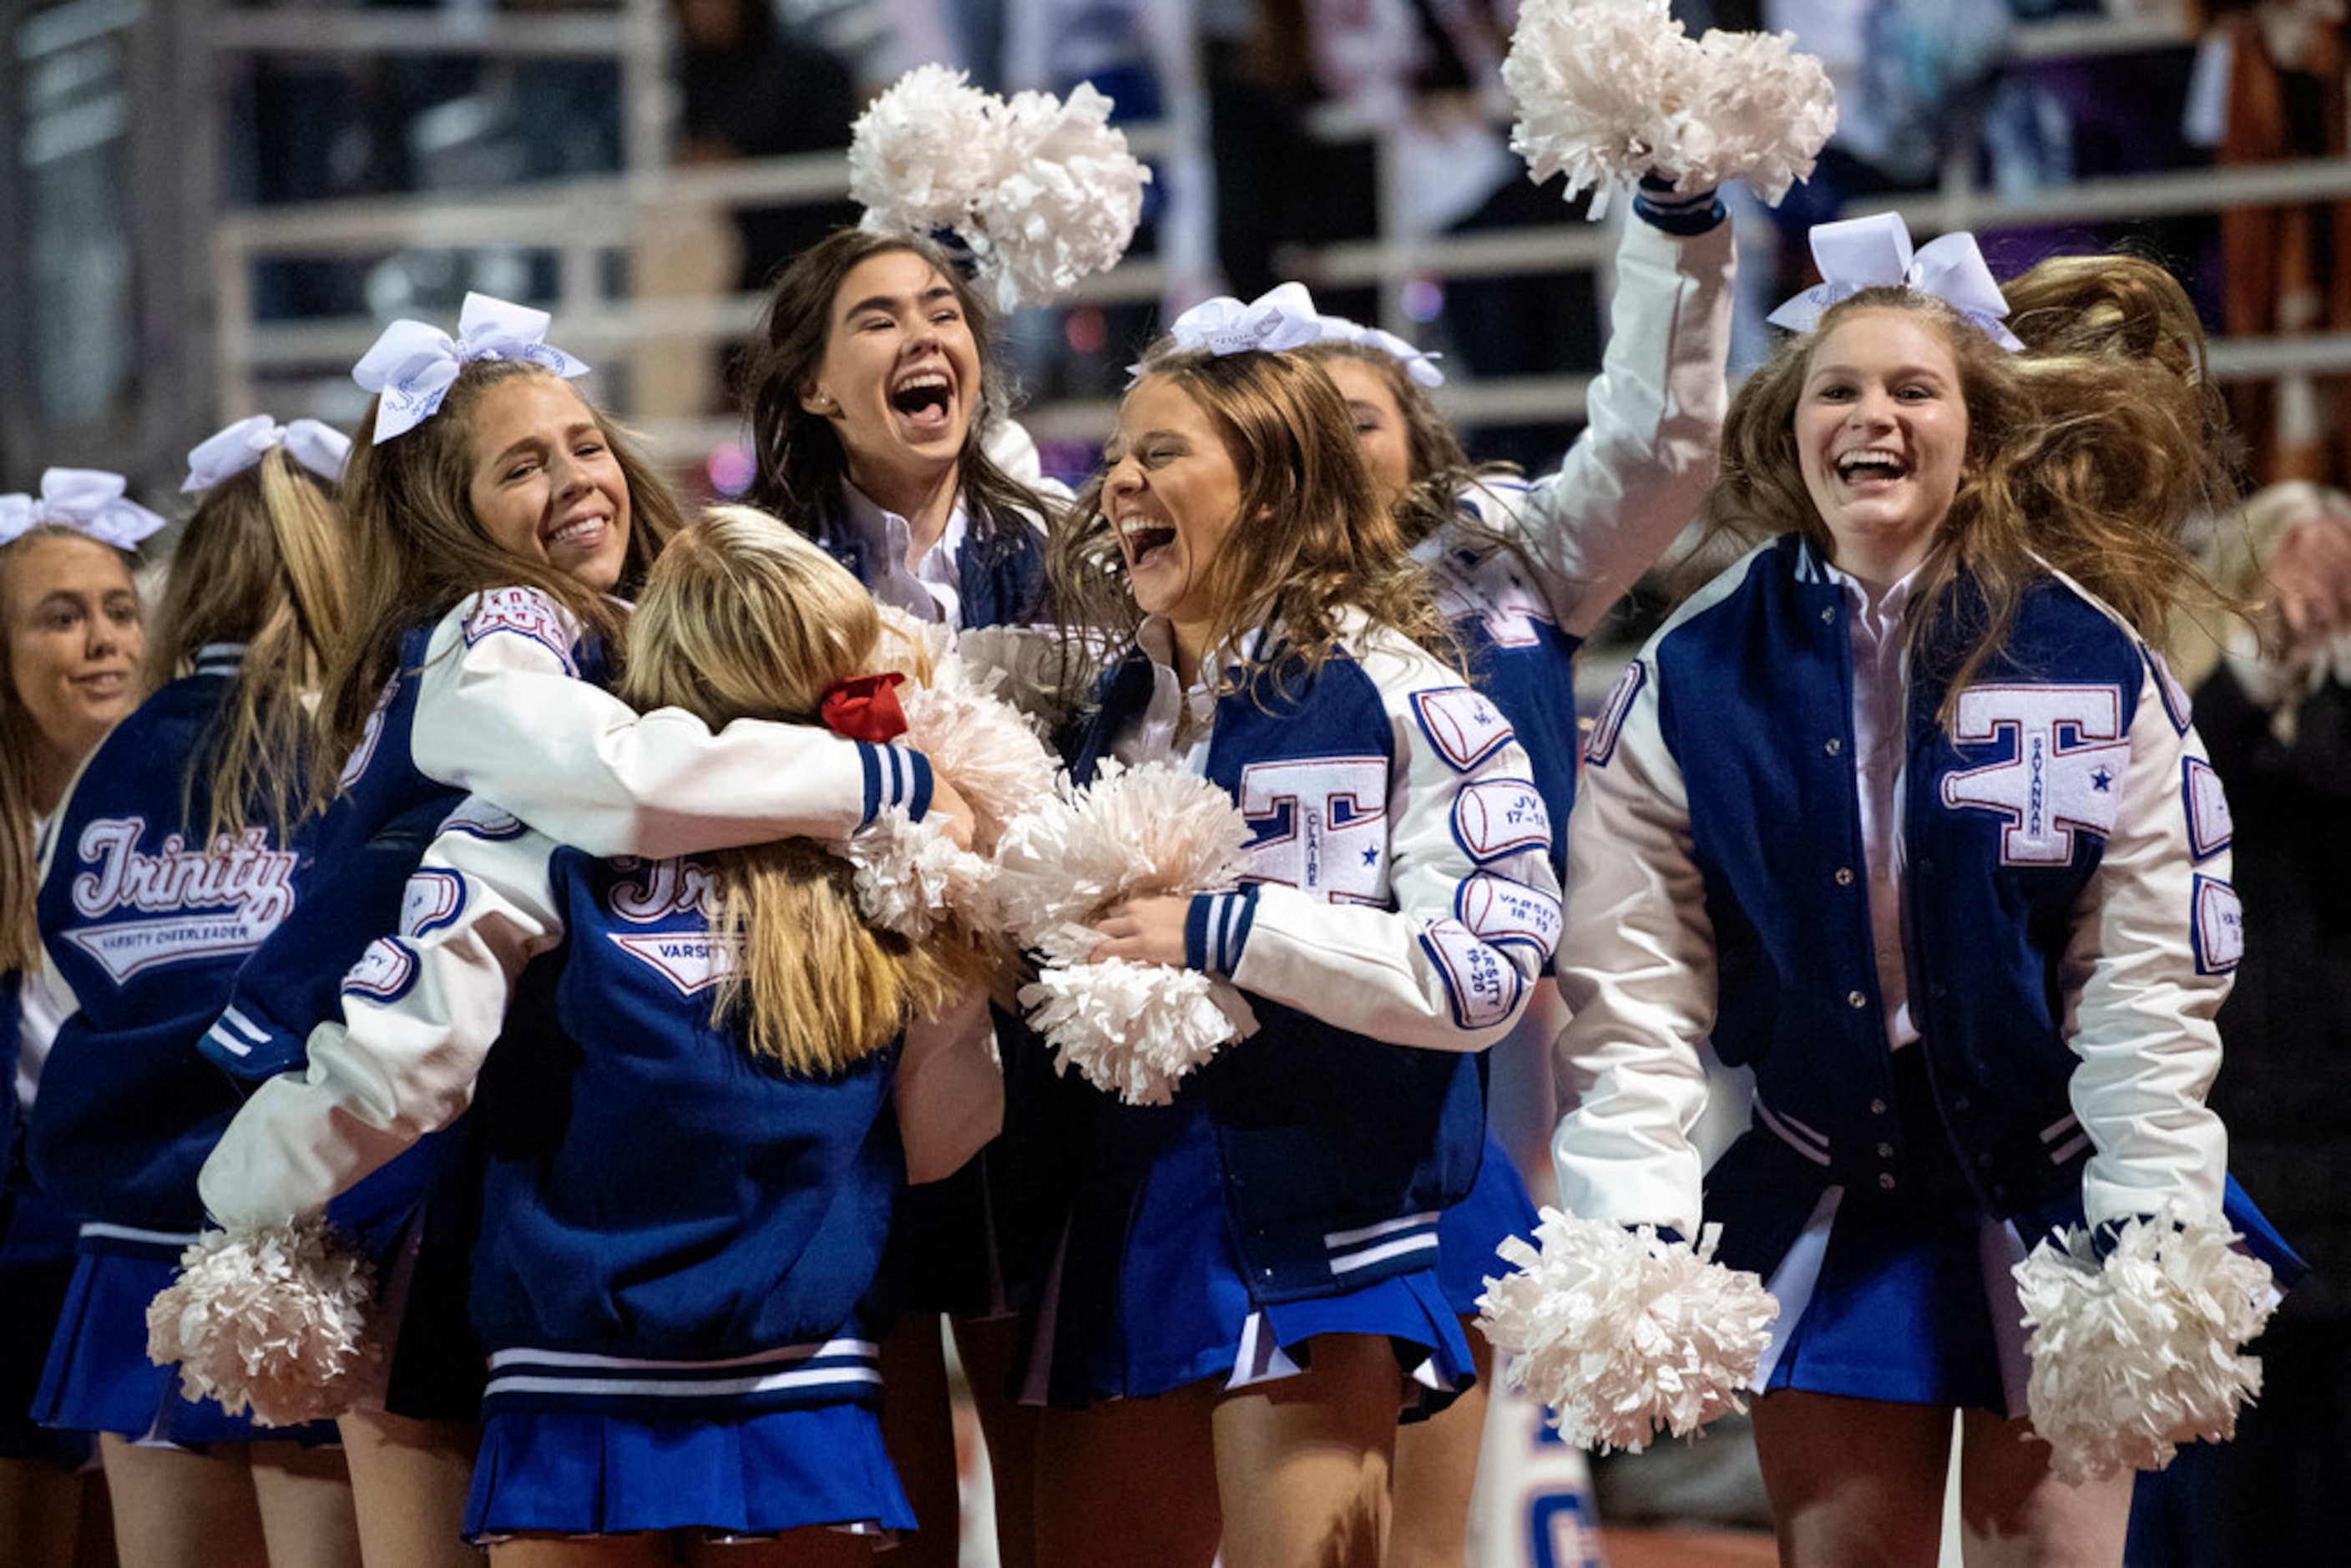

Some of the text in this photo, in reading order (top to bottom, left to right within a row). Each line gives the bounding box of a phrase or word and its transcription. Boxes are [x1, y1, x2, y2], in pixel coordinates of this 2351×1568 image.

[1514, 796, 1537, 810] JV
[2031, 736, 2042, 836] SAVANNAH
[73, 817, 298, 925] Trinity
[1307, 813, 1318, 887] CLAIRE
[102, 925, 249, 949] VARSITY CHEERLEADER
[1512, 907, 1549, 933] 18-19
[659, 944, 723, 959] VARSI
[1467, 948, 1486, 993] 19-20
[1481, 947, 1501, 1007] ARSITY
